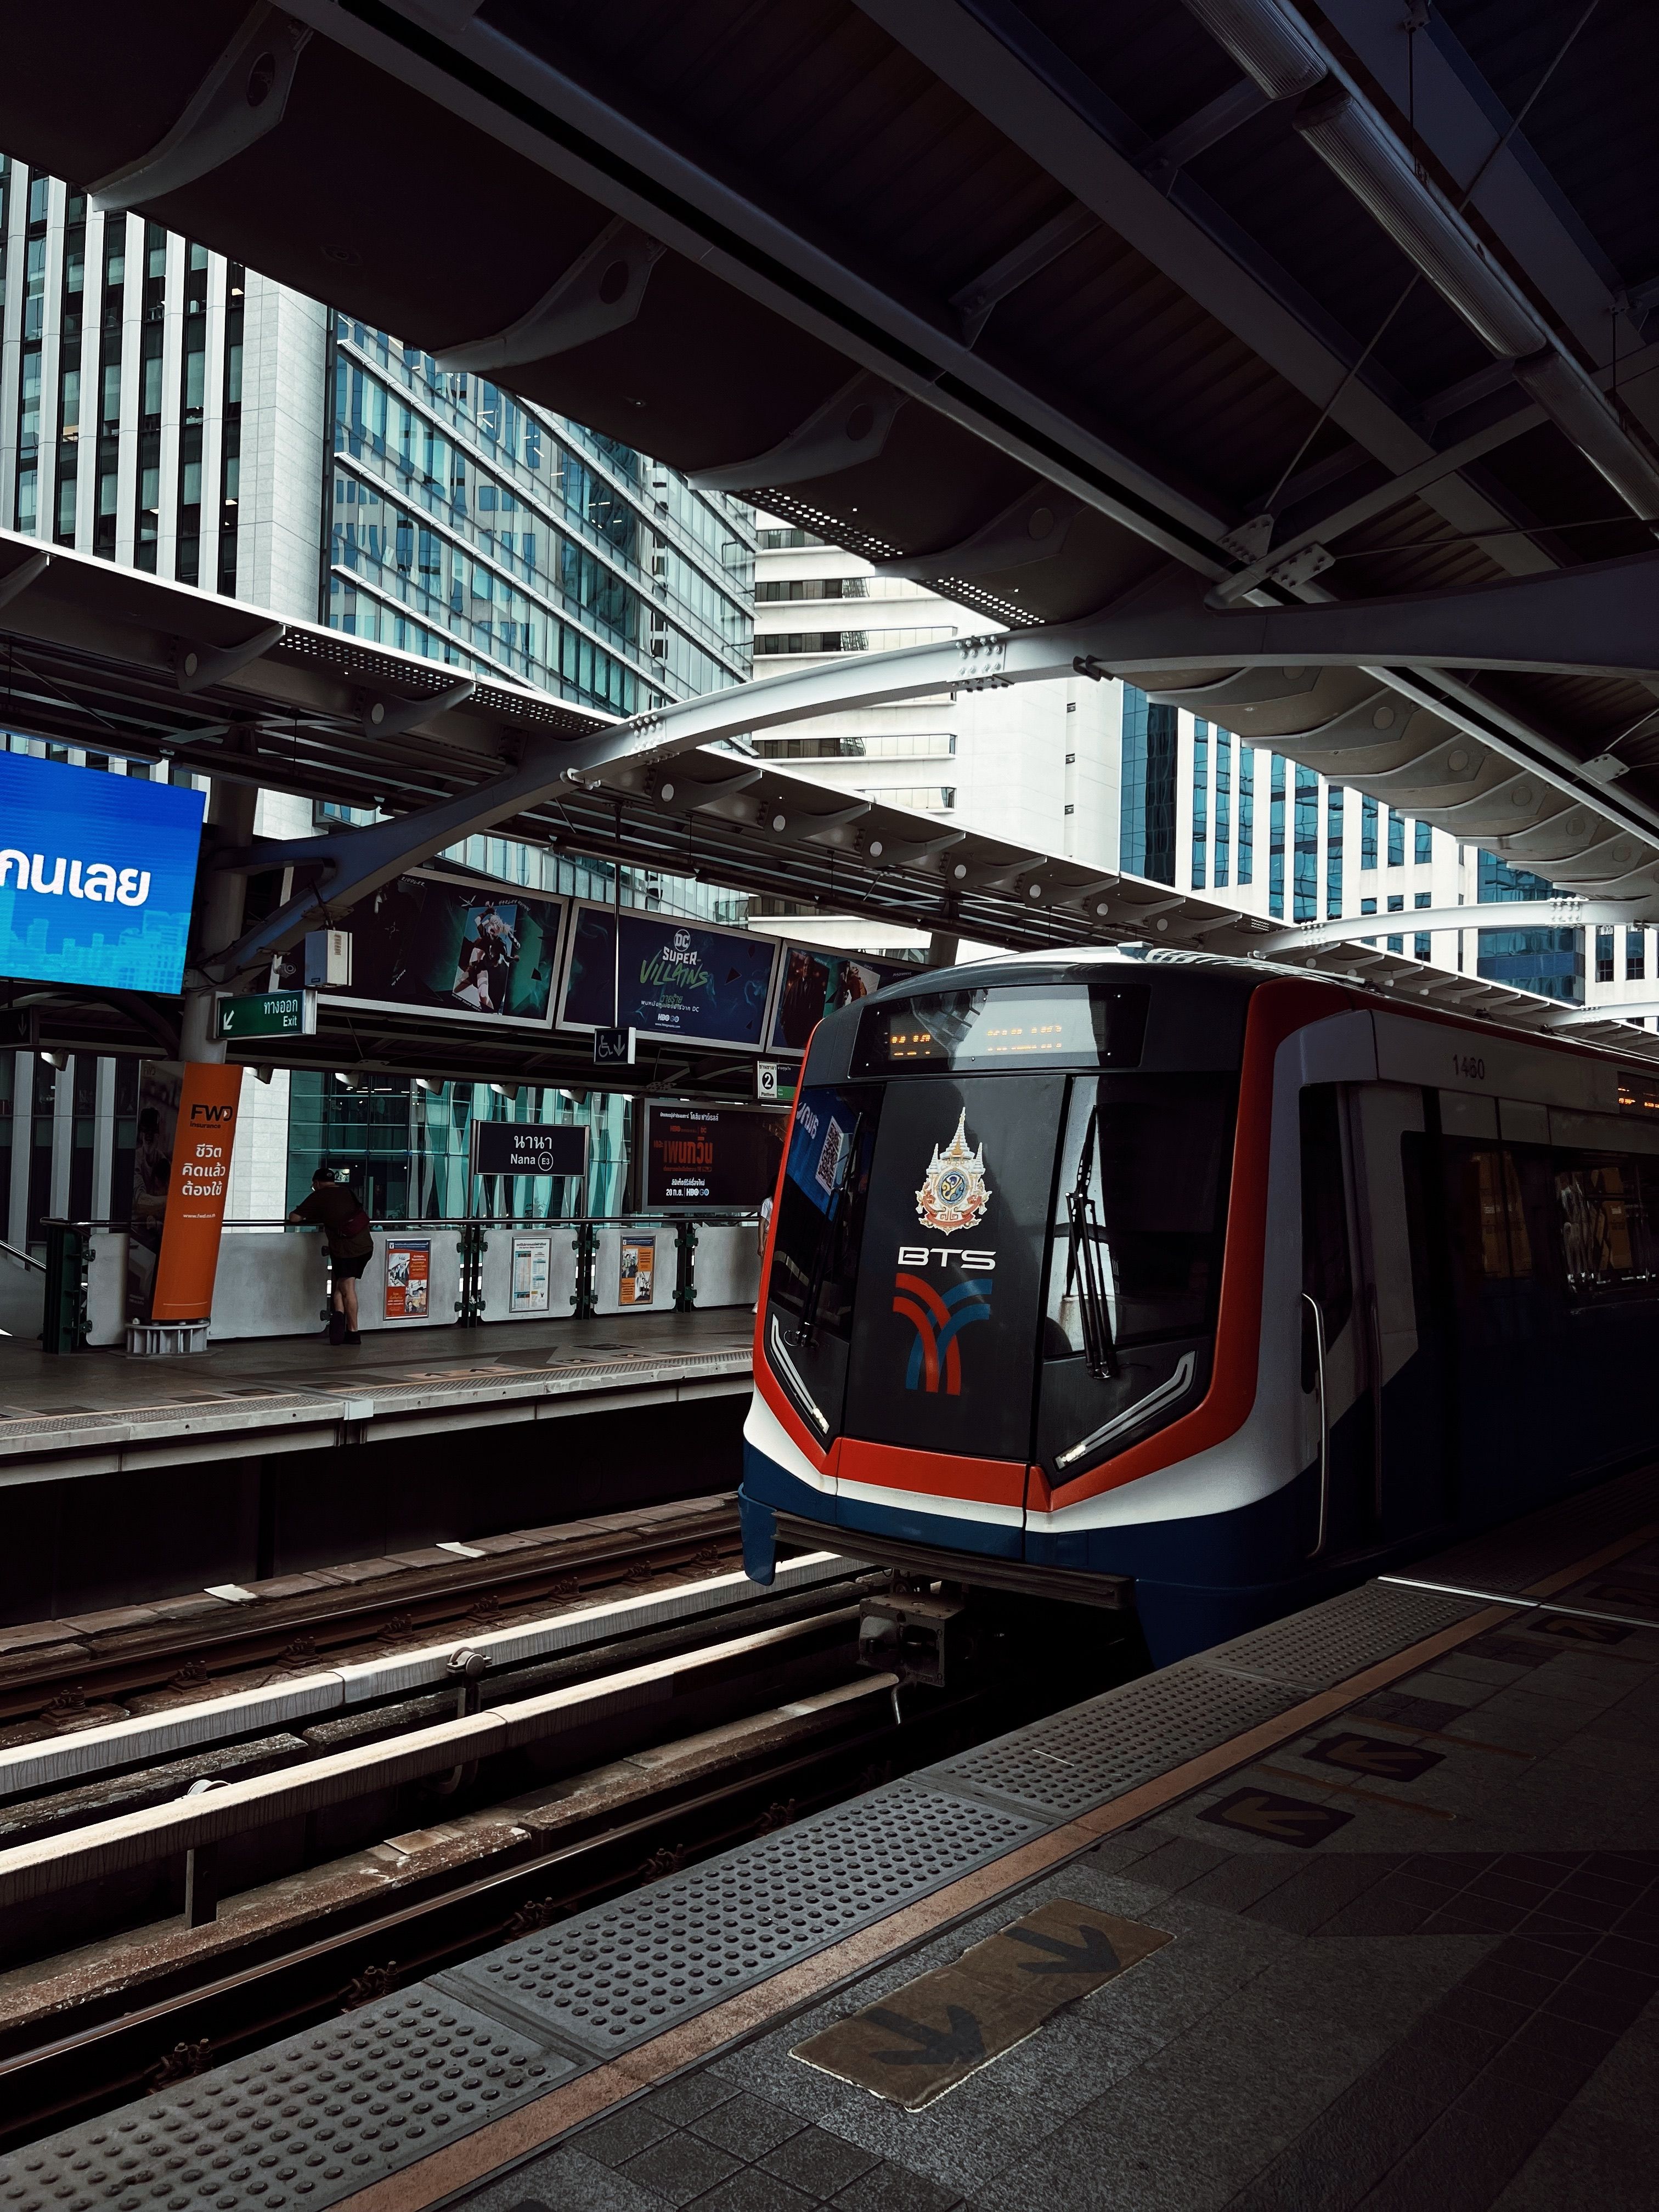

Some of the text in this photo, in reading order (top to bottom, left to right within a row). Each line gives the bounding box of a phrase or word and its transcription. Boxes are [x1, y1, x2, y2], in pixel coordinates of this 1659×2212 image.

[639, 949, 708, 989] VILLAINS
[264, 999, 298, 1014] ทางออก
[283, 1015, 297, 1026] Exit
[657, 1013, 670, 1022] HBO
[1453, 1054, 1485, 1079] 1460
[764, 1073, 771, 1087] 2
[190, 1104, 233, 1122] FWD
[514, 1135, 552, 1149] นานา
[195, 1143, 222, 1158] ชีวิต
[511, 1154, 550, 1165] Nana E3
[182, 1162, 226, 1177] คิดแล้ว
[182, 1181, 223, 1196] ต้องใช้
[897, 1246, 996, 1271] BTS
